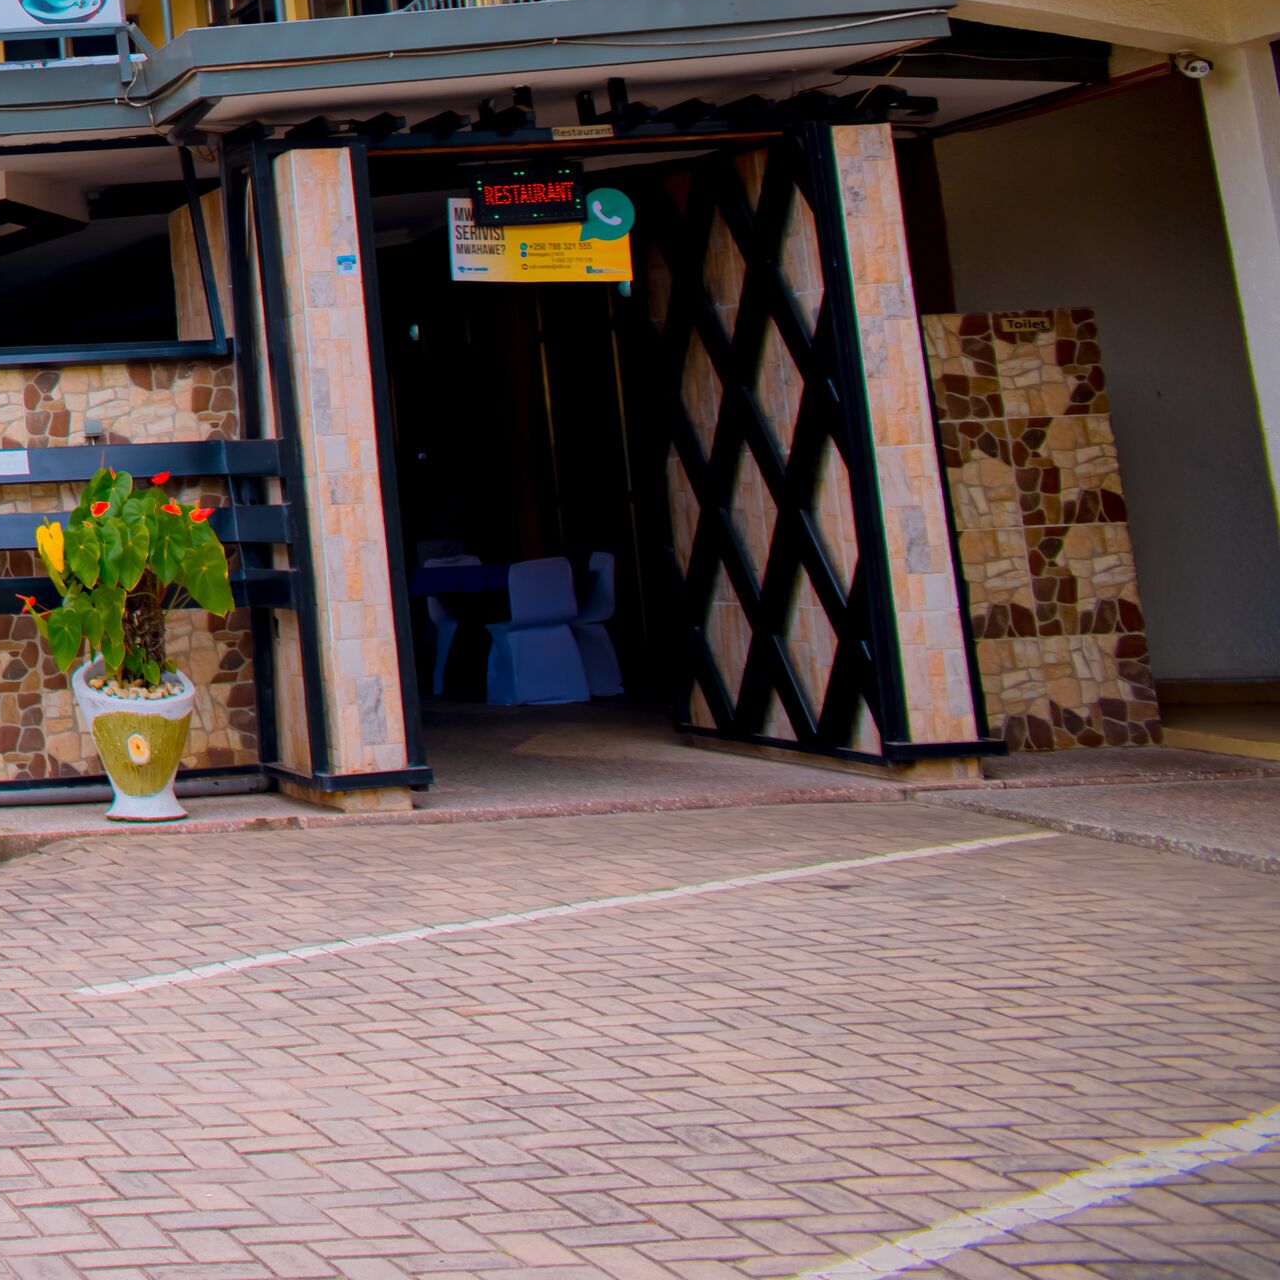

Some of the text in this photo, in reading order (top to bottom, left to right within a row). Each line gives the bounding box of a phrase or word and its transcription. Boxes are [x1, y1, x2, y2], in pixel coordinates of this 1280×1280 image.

[553, 126, 612, 137] Restaurant
[484, 182, 574, 205] RESTAURANT
[456, 244, 506, 255] MWAHAWE?
[1006, 319, 1048, 330] Toilet
